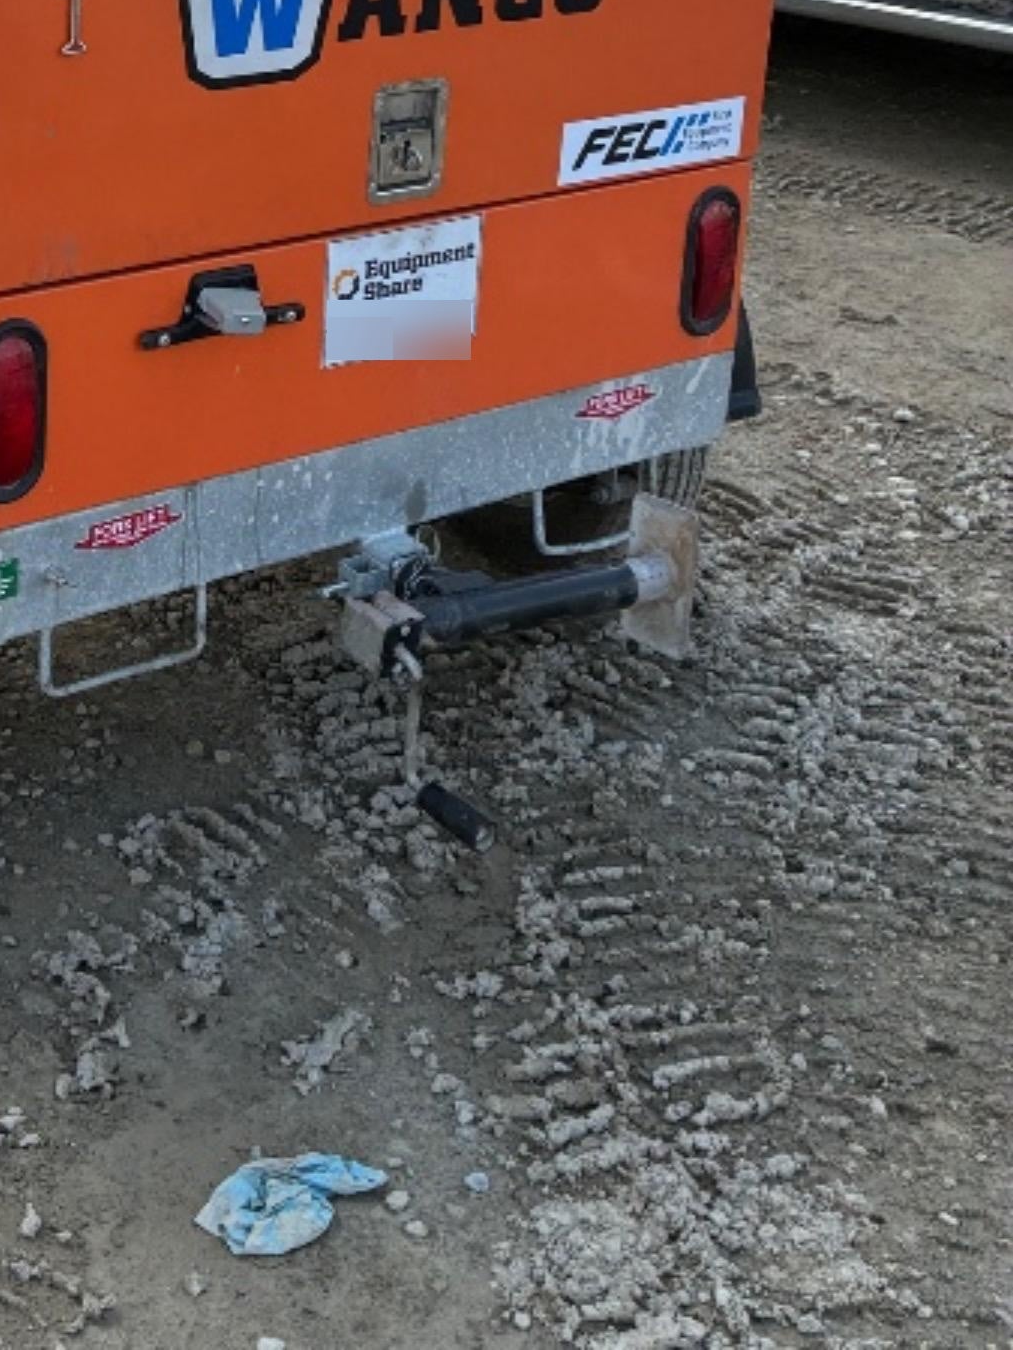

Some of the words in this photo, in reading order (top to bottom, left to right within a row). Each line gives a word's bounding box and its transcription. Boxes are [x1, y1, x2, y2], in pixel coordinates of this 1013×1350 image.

[572, 119, 667, 171] FEC
[364, 242, 475, 280] Equipment
[363, 278, 424, 300] Share
